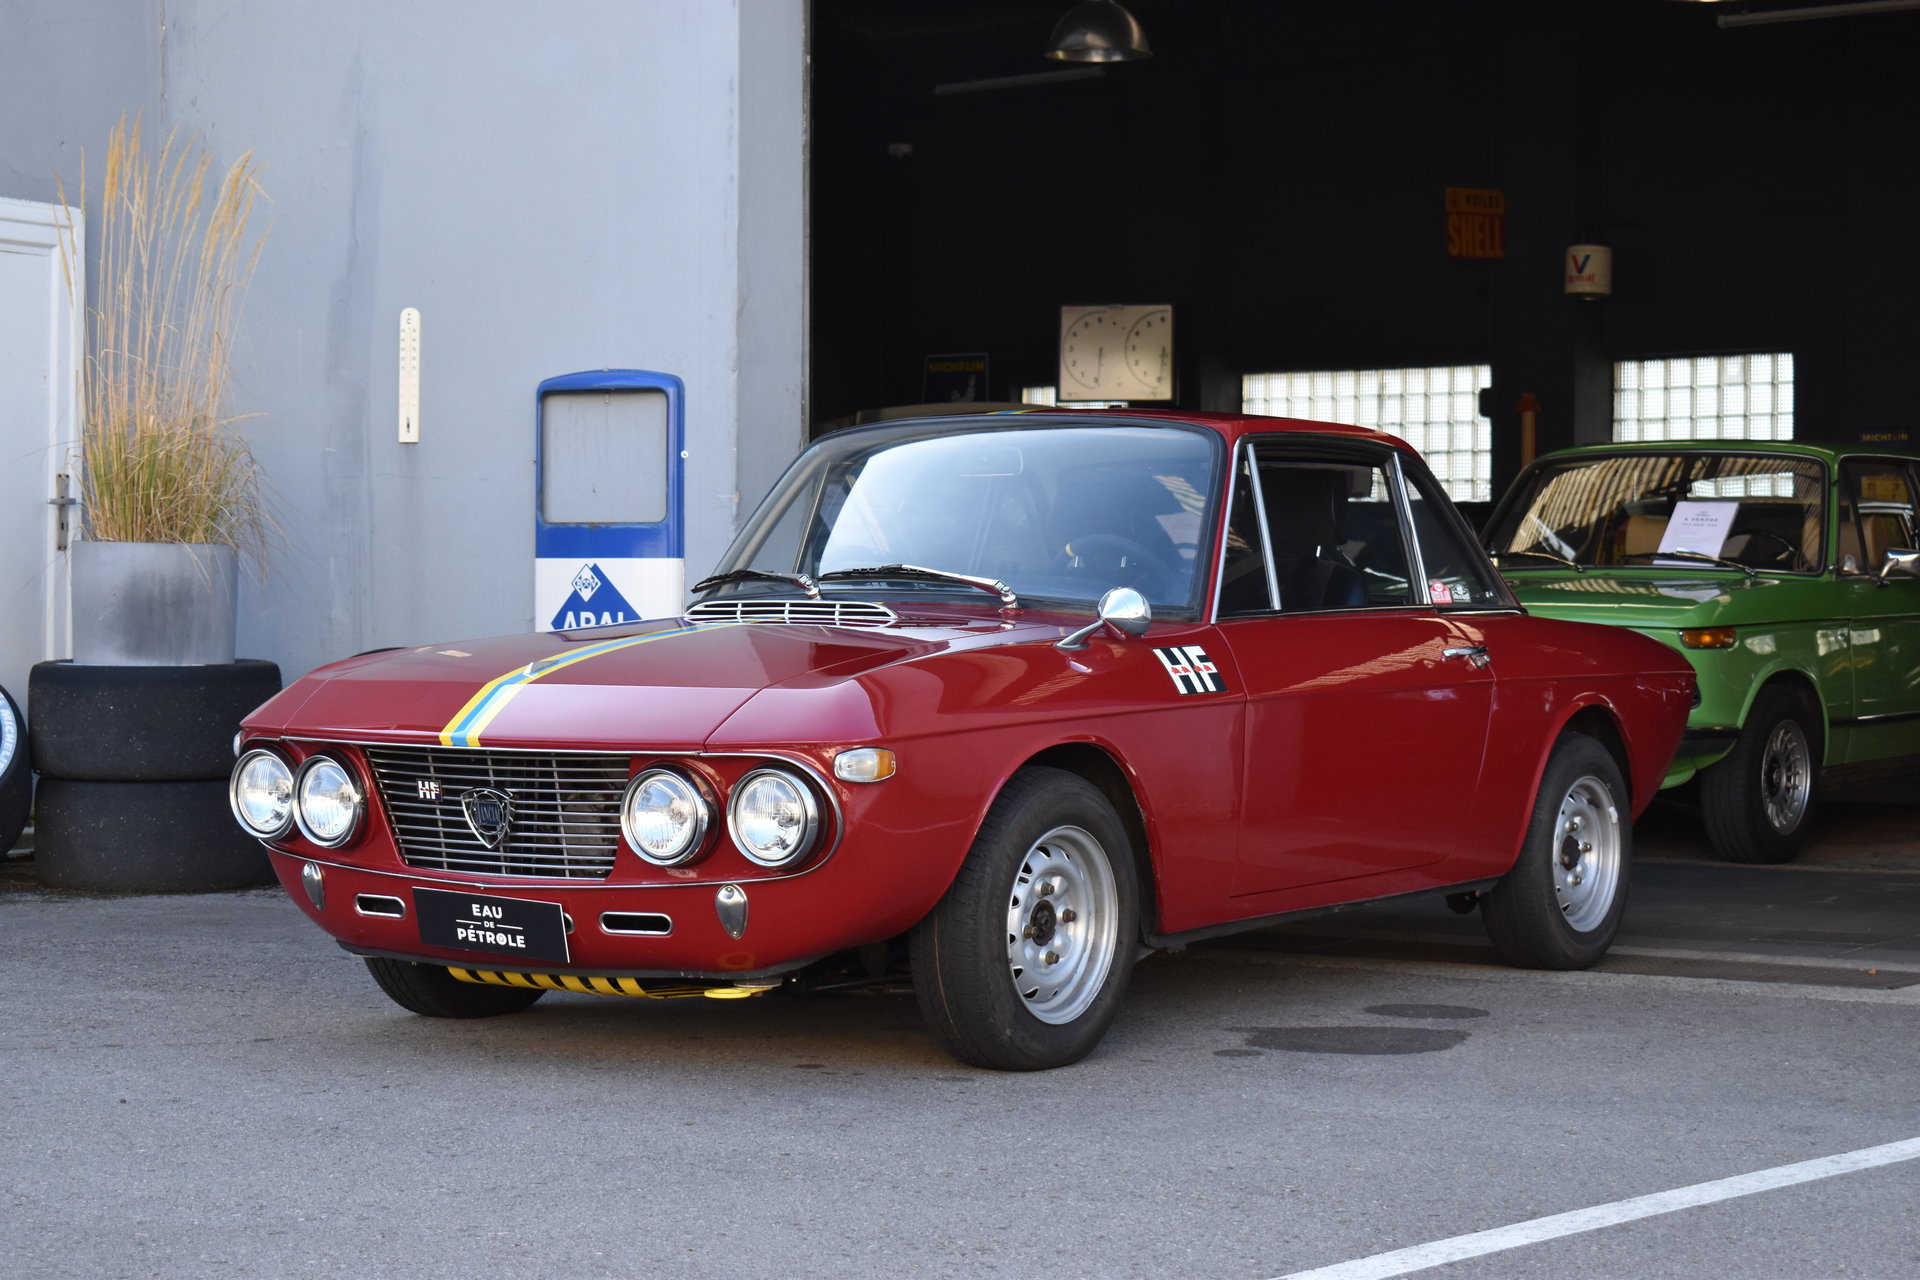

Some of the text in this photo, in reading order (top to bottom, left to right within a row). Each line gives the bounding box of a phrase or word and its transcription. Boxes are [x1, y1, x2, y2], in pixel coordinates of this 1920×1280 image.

[1448, 214, 1504, 257] SHELL
[1861, 432, 1909, 441] MICHELIN
[1152, 645, 1217, 694] HF
[418, 781, 440, 800] HF
[472, 903, 502, 919] EAU
[457, 925, 526, 948] PÉTROLE
